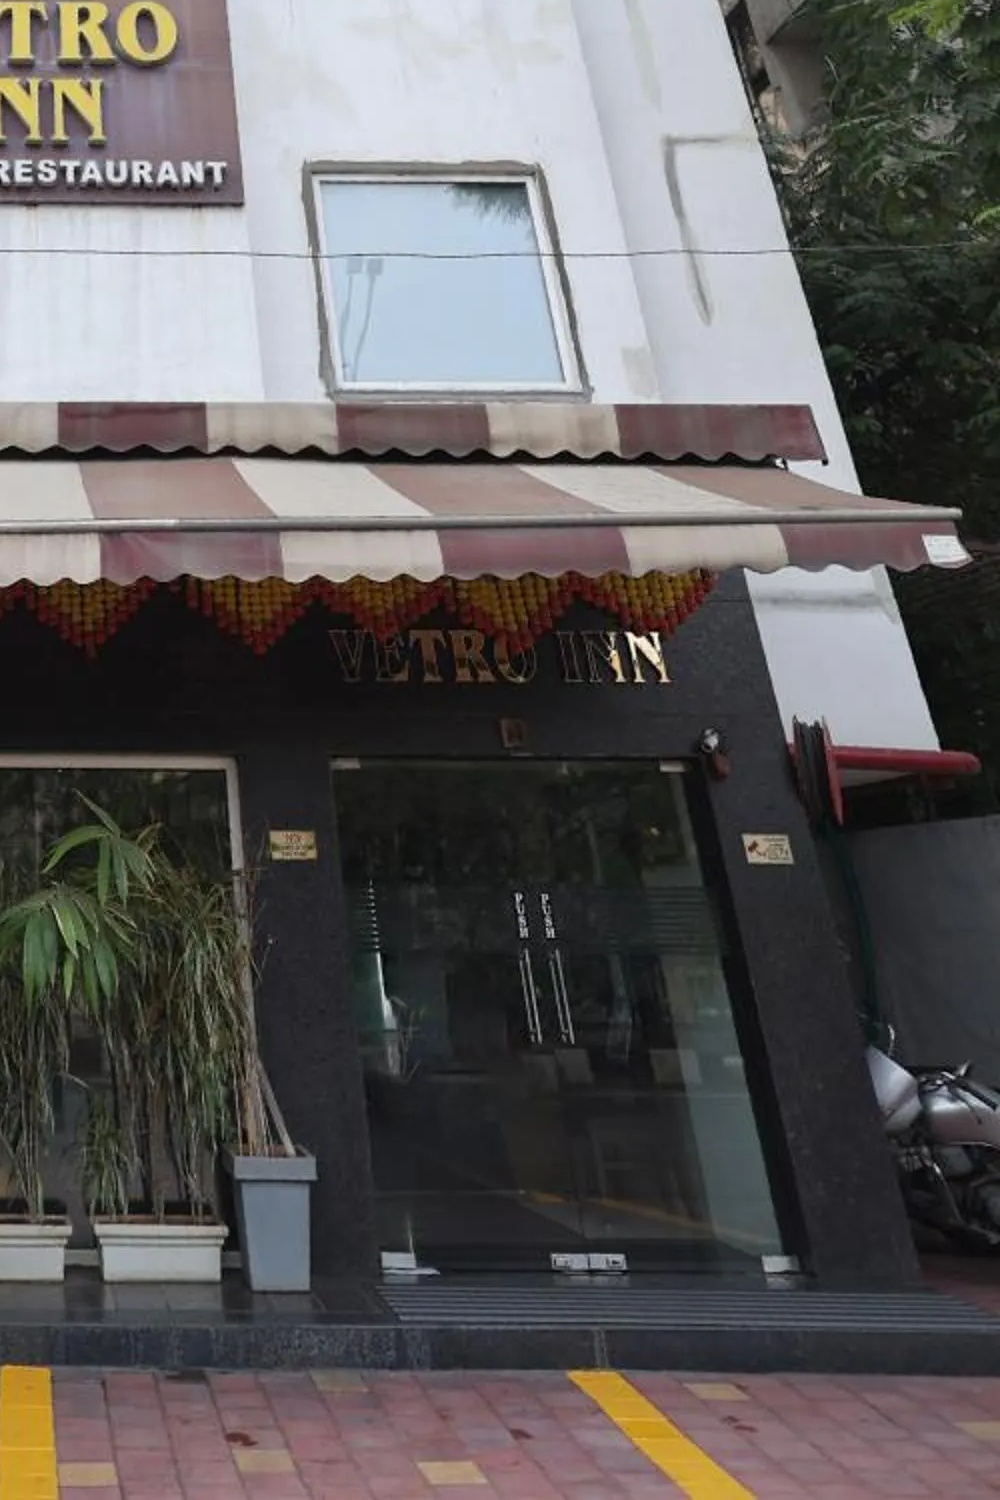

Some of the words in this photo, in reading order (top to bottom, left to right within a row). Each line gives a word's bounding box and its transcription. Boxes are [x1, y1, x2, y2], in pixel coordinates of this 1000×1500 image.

[328, 629, 538, 683] VETRO
[554, 630, 672, 683] INN
[513, 891, 529, 939] PUSH
[540, 892, 556, 939] PUSH
